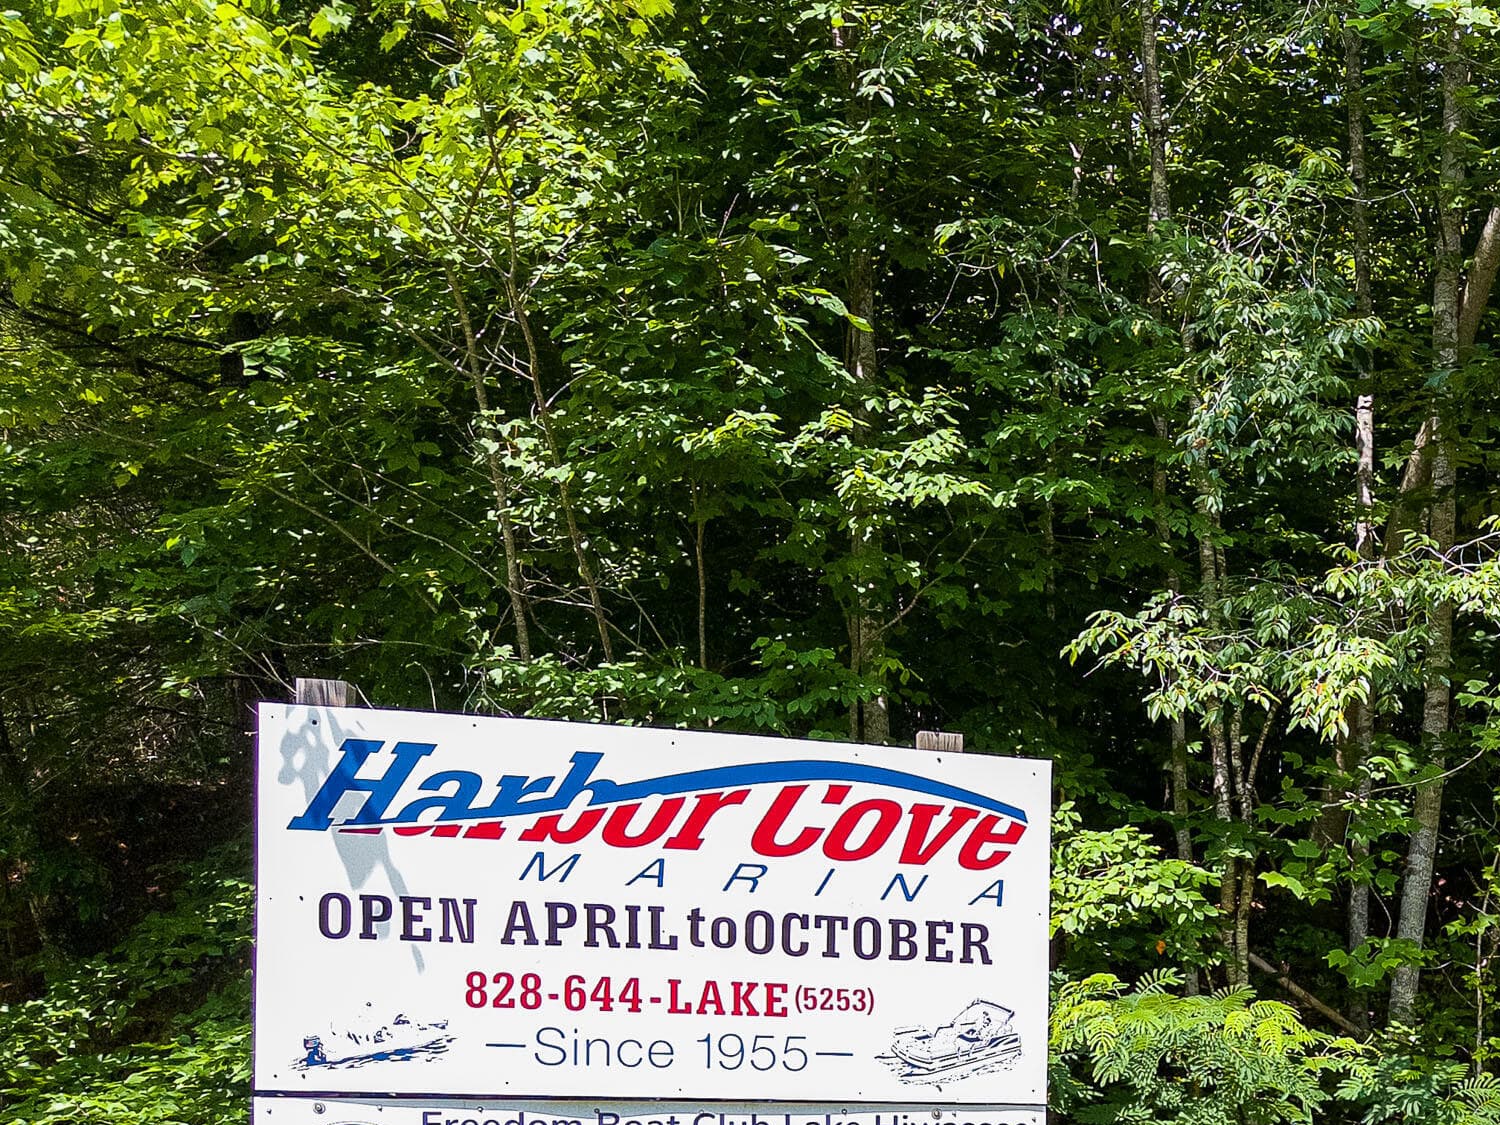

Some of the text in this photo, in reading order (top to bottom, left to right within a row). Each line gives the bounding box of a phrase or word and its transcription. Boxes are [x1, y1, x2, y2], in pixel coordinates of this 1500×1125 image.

[286, 738, 1029, 872] Harbor Cove
[519, 851, 1004, 906] MARINA
[317, 892, 478, 945] OPEN
[501, 900, 679, 951] APRIL
[745, 910, 994, 965] OCTOBER
[464, 970, 789, 1018] 828-644-LAKE
